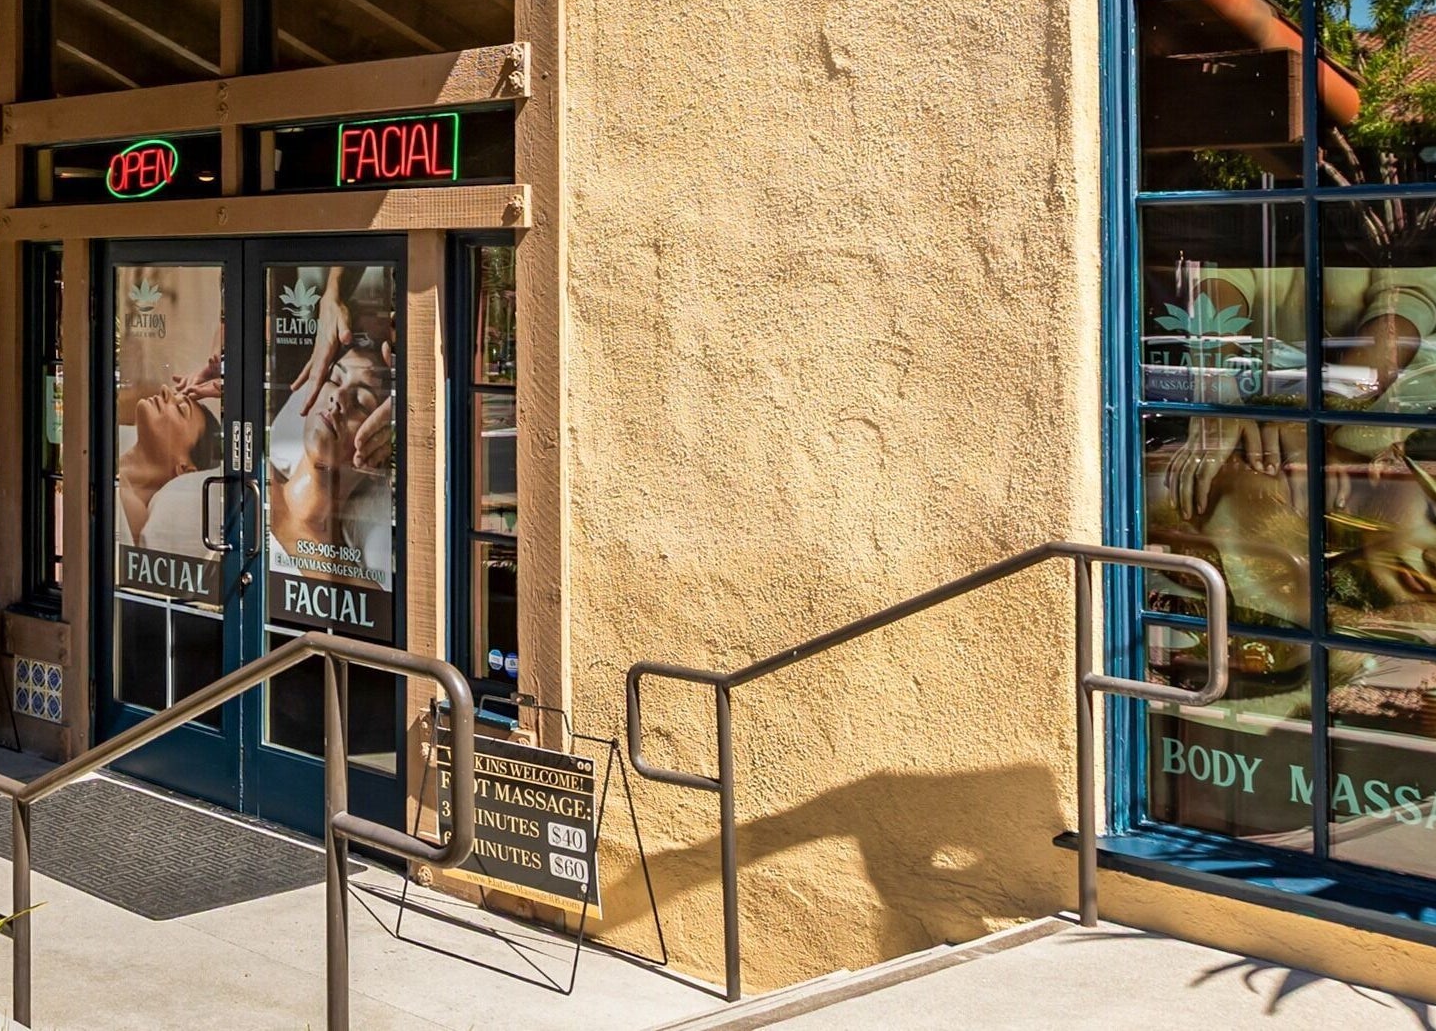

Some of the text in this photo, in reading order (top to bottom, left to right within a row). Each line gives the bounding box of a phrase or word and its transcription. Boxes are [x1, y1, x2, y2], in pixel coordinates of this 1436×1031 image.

[110, 149, 173, 191] OPEN
[342, 122, 452, 180] FACIAL
[276, 317, 318, 335] ELATIO
[296, 539, 362, 563] 858-905-1882
[127, 551, 209, 595] FACIAL
[284, 578, 375, 628] FACIAL
[486, 758, 507, 774] INS
[509, 762, 584, 791] WELCOME!
[1162, 737, 1263, 794] BODY
[494, 781, 592, 821] MASSAGE:
[552, 825, 583, 850] $40
[554, 856, 585, 880] $60
